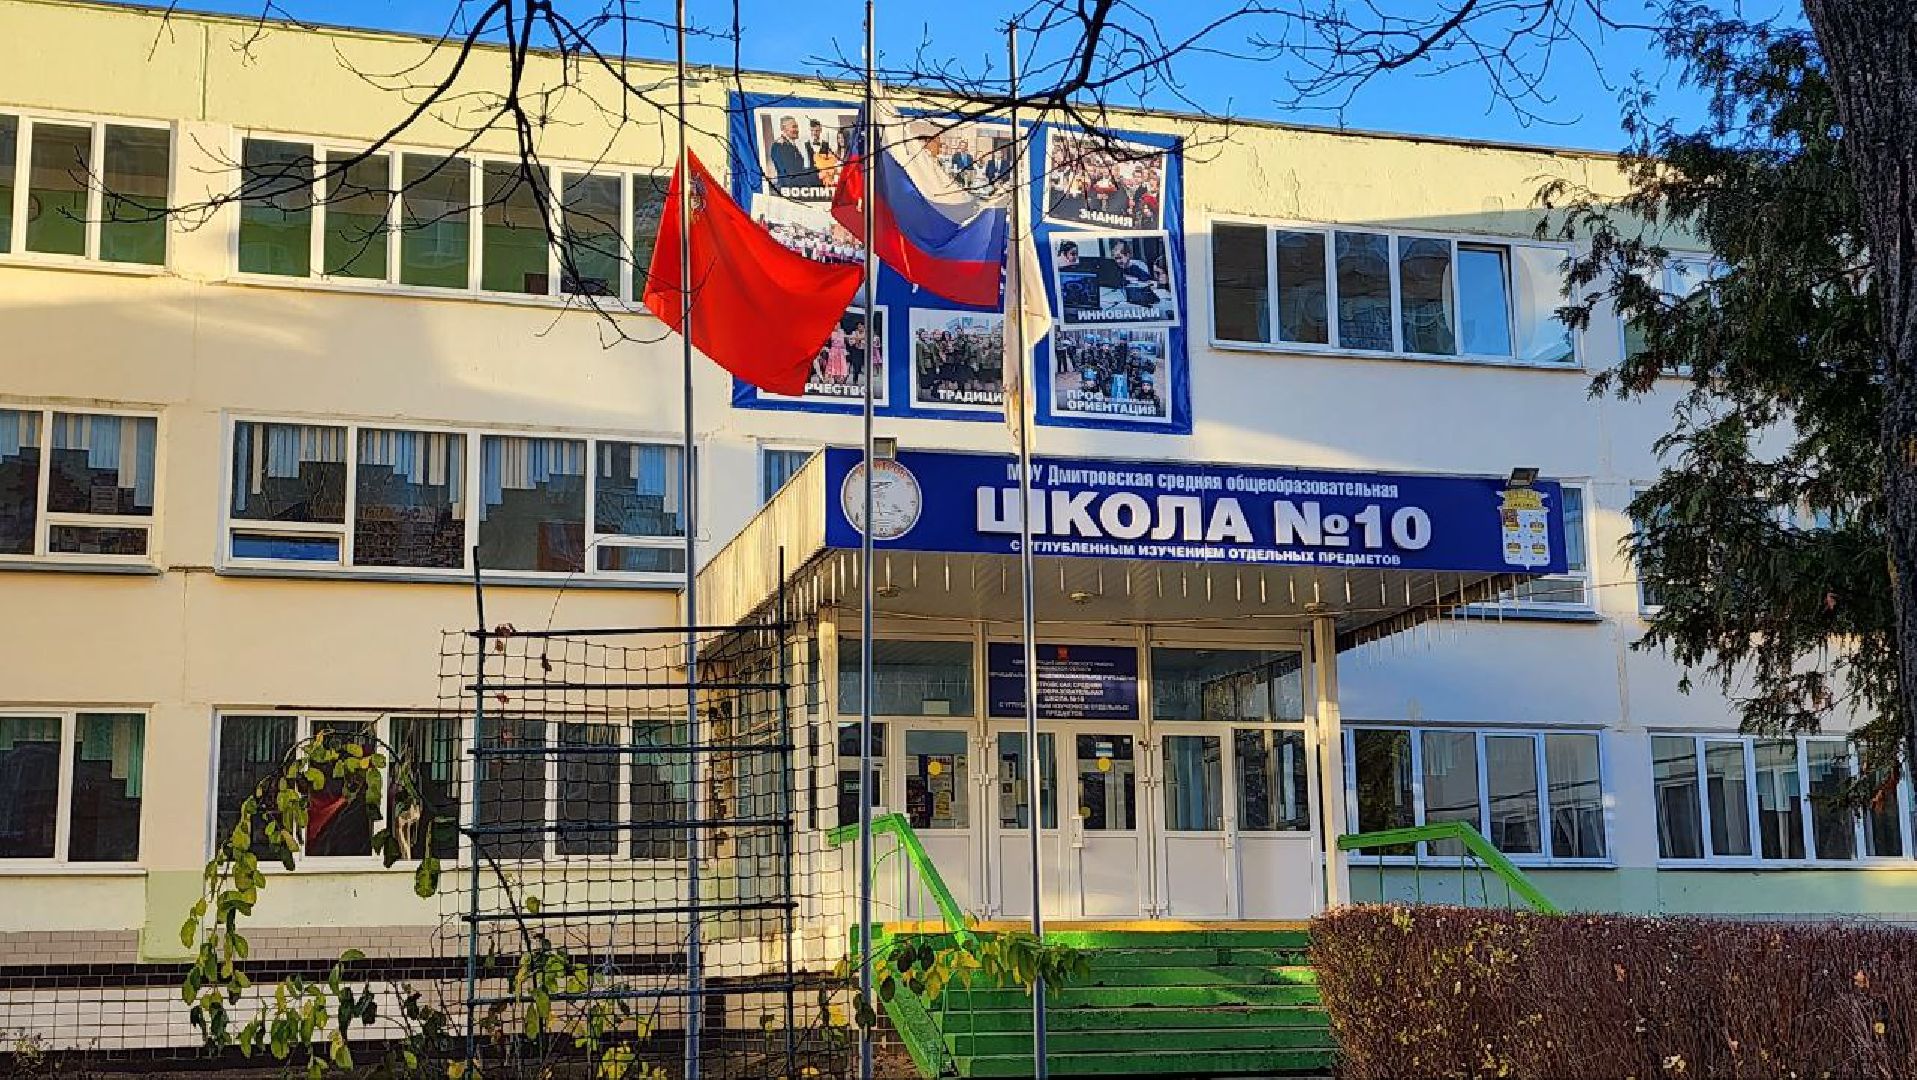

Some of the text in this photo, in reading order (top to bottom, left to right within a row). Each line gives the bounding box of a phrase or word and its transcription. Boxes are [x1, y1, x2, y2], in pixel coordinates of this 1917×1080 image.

[780, 186, 837, 198] ВОСПИТ
[1079, 208, 1133, 228] ЗНАНИЯ
[1077, 307, 1160, 320] ИННОВАЦИИ
[805, 382, 866, 396] РЧЕСТВ
[937, 389, 1003, 404] ТРАДИЦИ
[1067, 389, 1105, 402] ПРОФ
[1067, 400, 1157, 415] ОРИЕНТАЦИЯ
[1048, 465, 1154, 487] Дмитровская
[1158, 472, 1223, 491] средняя
[1226, 474, 1398, 499] общеобразовательная
[976, 486, 1432, 550] ШКОЛА №10
[1010, 540, 1400, 565] С ГЛУБЛЕННЫМ ИЗУЧЕНИЕМ ОТДЕЛЬНЫХ ПРЕДМЕТОВ
